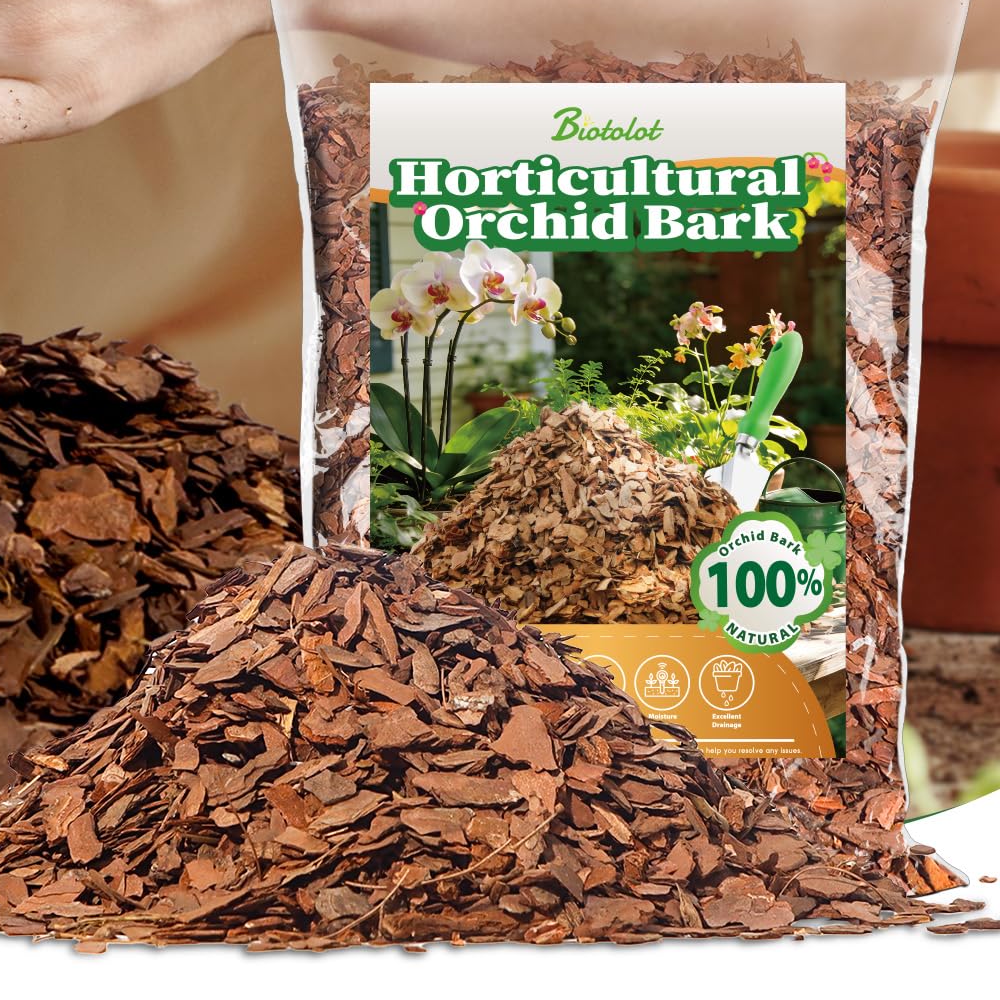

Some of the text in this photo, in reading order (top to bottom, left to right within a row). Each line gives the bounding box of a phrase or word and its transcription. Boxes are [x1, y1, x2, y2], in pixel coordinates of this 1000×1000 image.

[551, 106, 664, 142] Biotolot
[396, 155, 801, 196] Horticultural
[421, 201, 792, 240] Orchid Bark
[719, 530, 802, 557] Orchid Bark
[707, 560, 822, 608] 100%
[725, 622, 799, 645] NATURAL
[711, 721, 742, 729] Drainage
[705, 746, 721, 755] help
[738, 746, 764, 754] resolve
